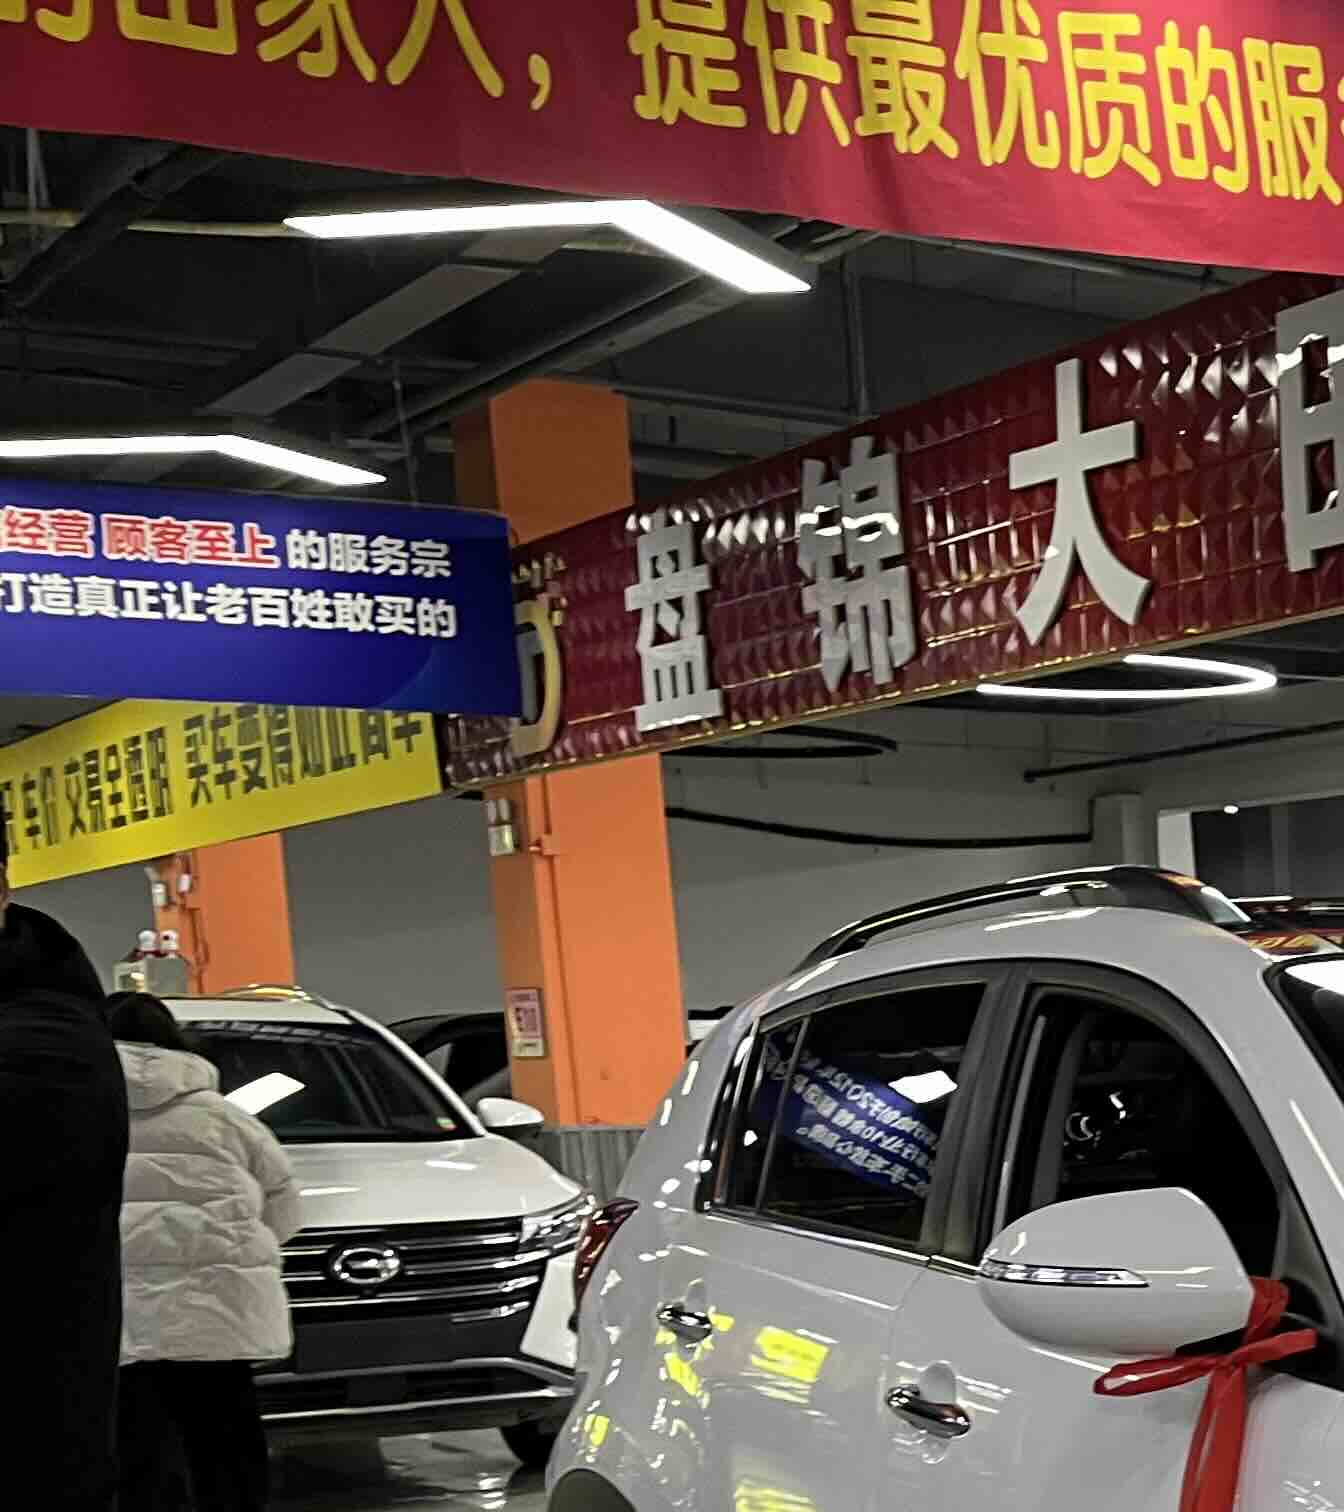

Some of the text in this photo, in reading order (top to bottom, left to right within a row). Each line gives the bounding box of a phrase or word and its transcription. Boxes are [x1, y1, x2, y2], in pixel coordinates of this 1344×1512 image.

[102, 513, 280, 568] 顾客至上
[286, 529, 452, 578] 的服务宗
[0, 573, 457, 637] 打造真正让老百姓敢买的
